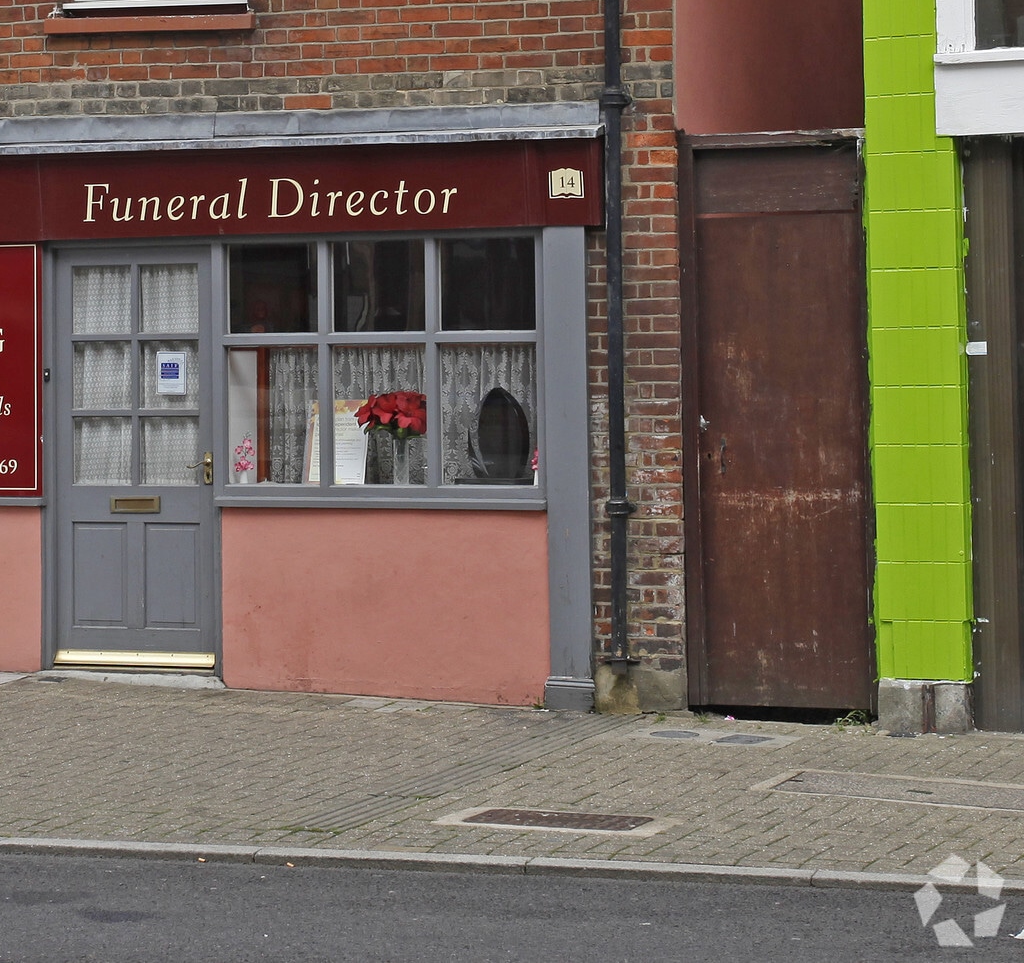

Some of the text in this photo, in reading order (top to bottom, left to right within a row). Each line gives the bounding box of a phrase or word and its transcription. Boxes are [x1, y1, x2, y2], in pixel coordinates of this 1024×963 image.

[559, 176, 576, 188] 14
[82, 176, 459, 223] Funeral Director
